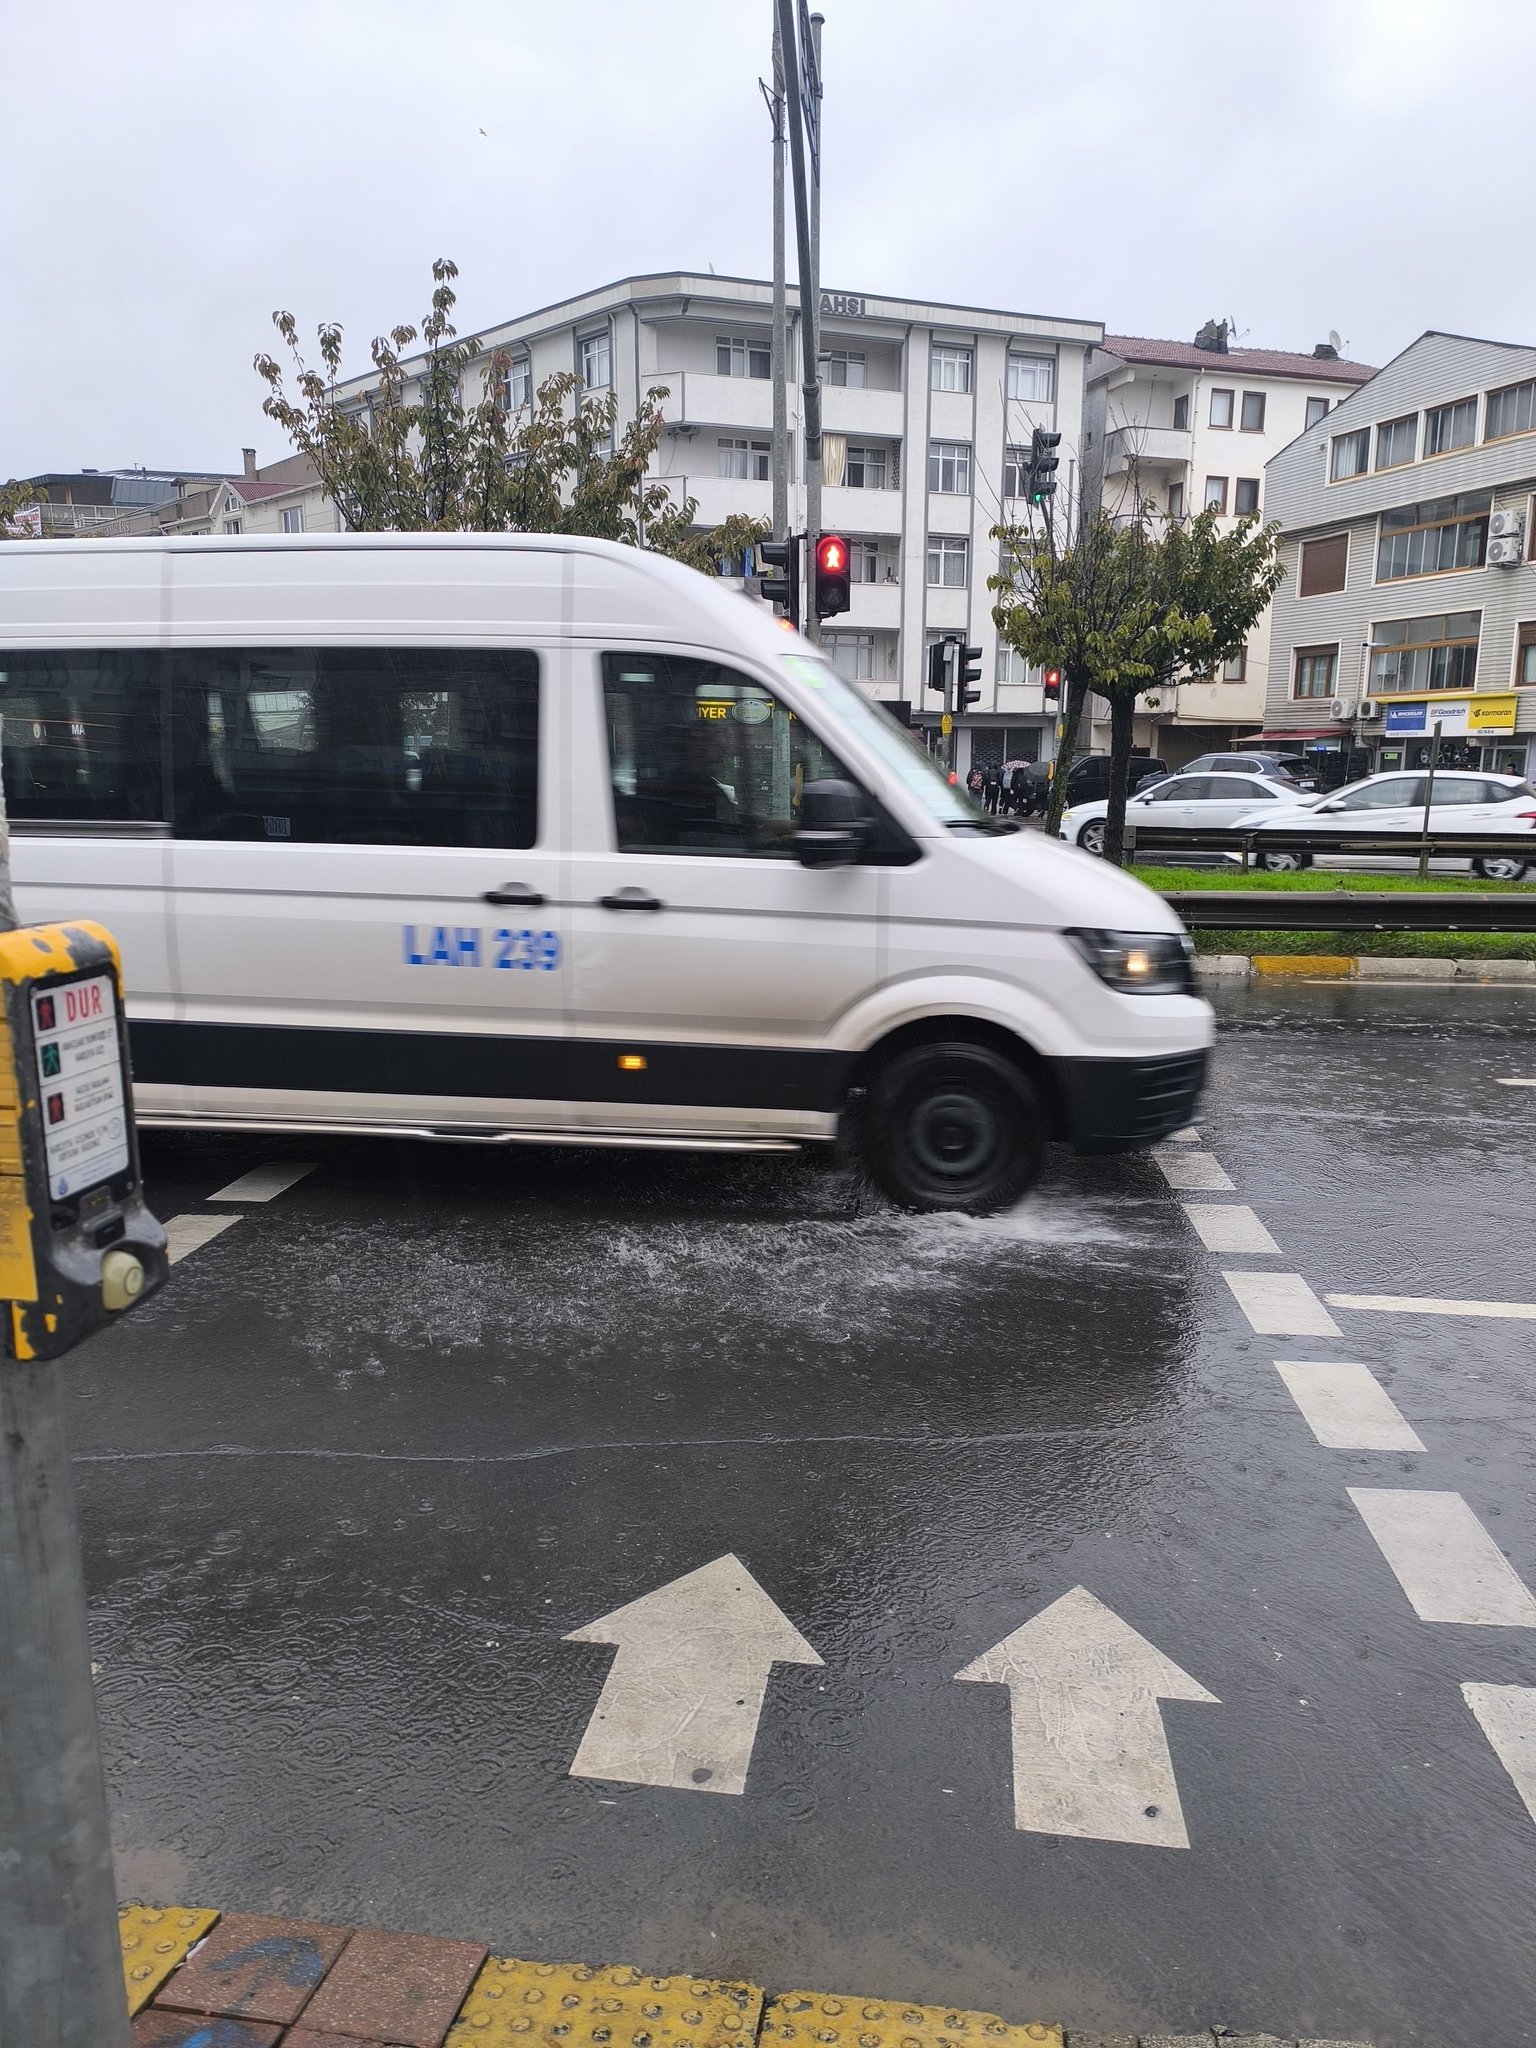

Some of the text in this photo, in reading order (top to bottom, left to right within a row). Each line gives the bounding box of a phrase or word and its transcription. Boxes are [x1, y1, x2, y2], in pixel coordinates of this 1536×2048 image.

[402, 925, 562, 971] LAH 239
[64, 984, 102, 1022] DUR
